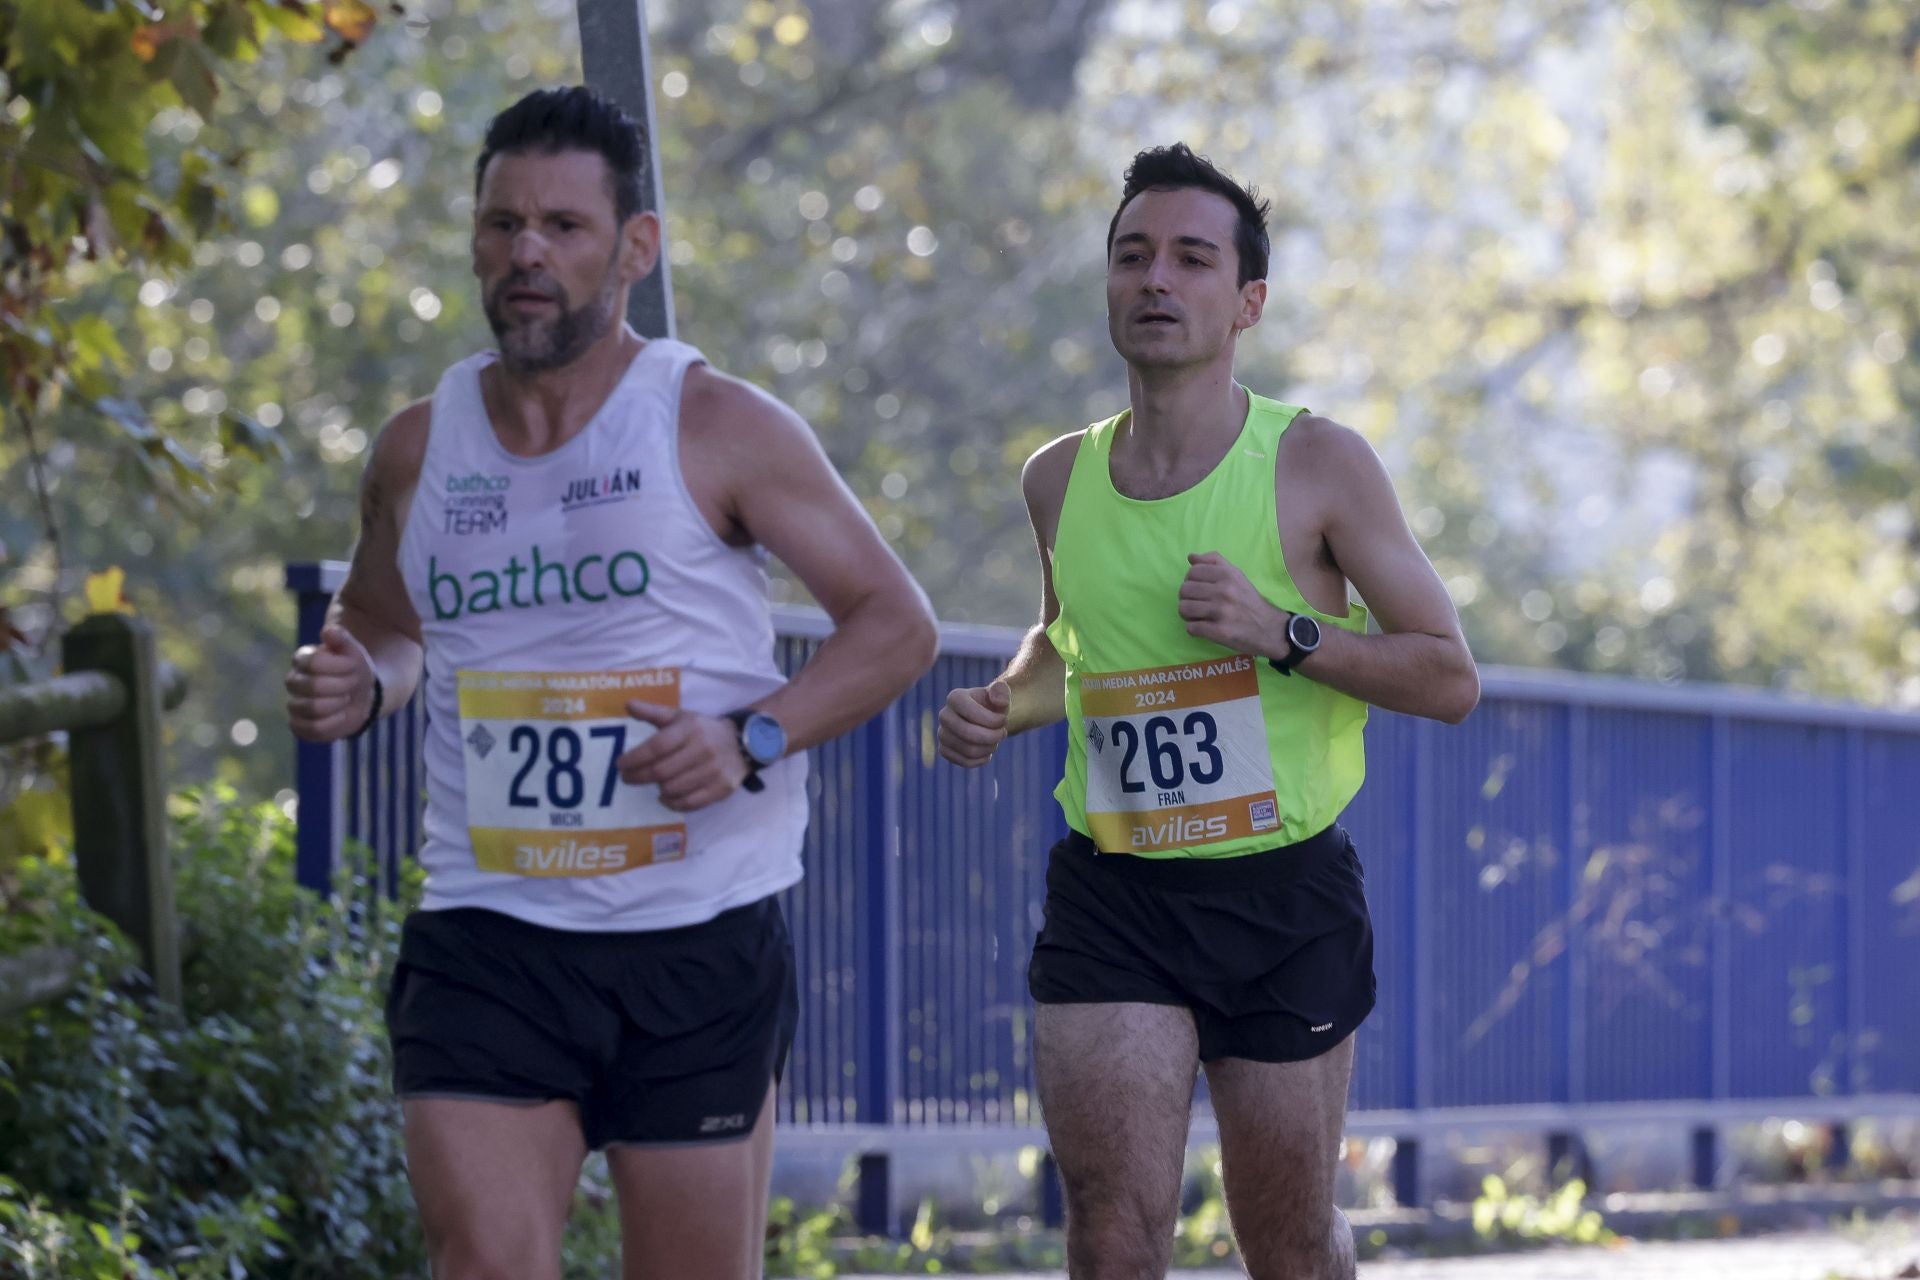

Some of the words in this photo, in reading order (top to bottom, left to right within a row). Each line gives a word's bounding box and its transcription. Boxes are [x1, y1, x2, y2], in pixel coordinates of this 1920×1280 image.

[445, 471, 511, 493] bathco
[560, 467, 641, 503] JULIÁN
[444, 509, 508, 535] TEAM
[429, 544, 651, 621] bathco
[624, 669, 675, 688] AVILÉS
[1102, 675, 1137, 690] MEDIA
[1138, 665, 1204, 686] MARATÓN
[1206, 657, 1251, 677] AVILÉS
[543, 697, 587, 714] 2024
[1135, 690, 1177, 708] 2024
[509, 725, 626, 808] 287
[1111, 711, 1224, 794] 263
[1157, 791, 1185, 807] FRAN
[1131, 814, 1228, 845] avilés
